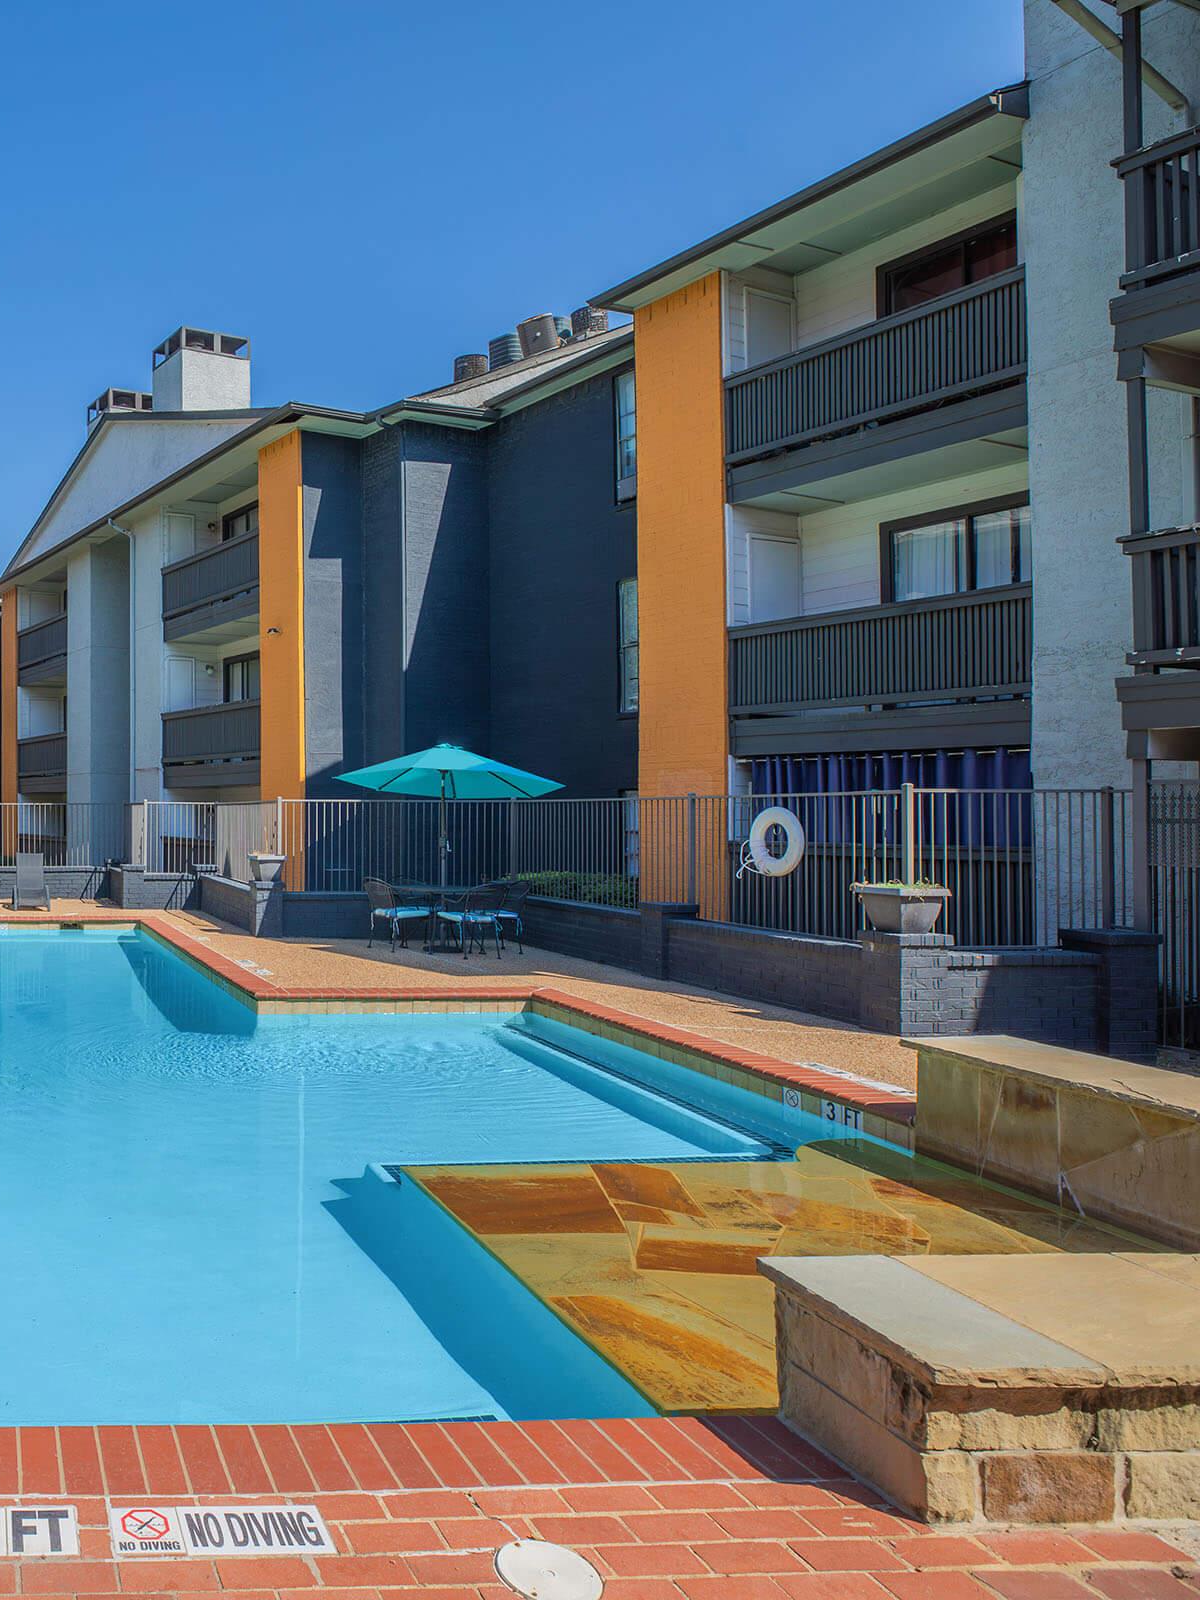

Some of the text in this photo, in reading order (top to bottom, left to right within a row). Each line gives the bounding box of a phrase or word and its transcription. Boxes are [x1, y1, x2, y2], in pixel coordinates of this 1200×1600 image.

[826, 1102, 860, 1129] 3 FT
[11, 1510, 69, 1552] FT
[184, 1511, 325, 1548] NO DIVING
[119, 1541, 181, 1551] NO DIVING
